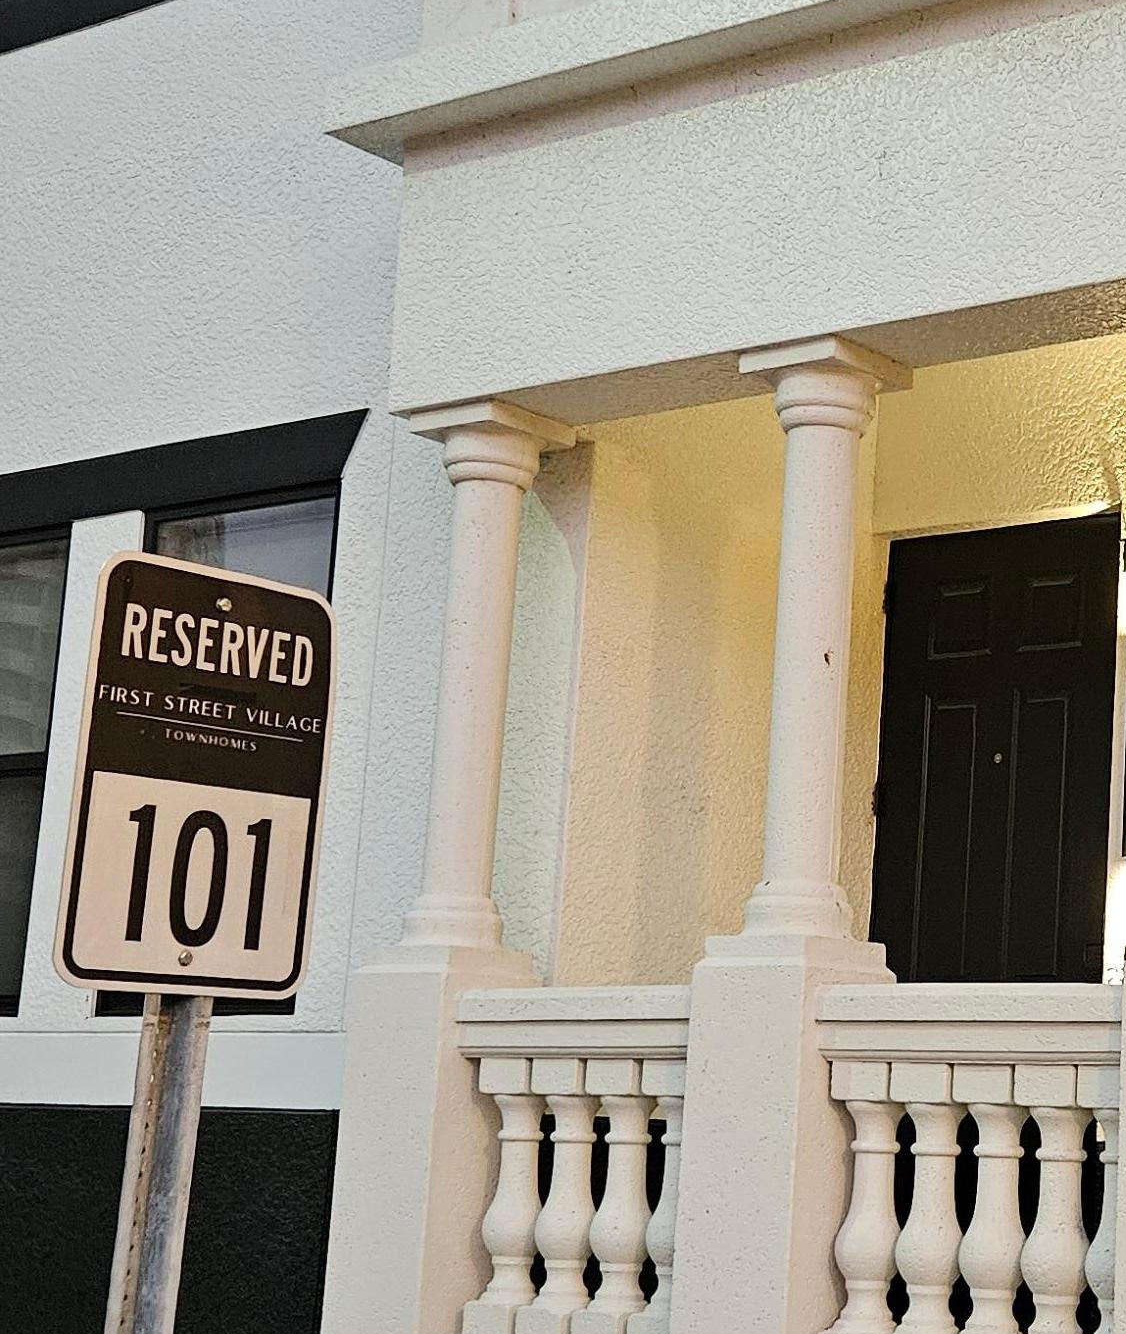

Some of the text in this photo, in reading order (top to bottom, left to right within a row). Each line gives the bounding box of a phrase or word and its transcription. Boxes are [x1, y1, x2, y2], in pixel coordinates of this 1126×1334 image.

[121, 602, 313, 687] RESERVED
[99, 684, 322, 734] FIRST STREET VILLAGE
[164, 728, 257, 752] TOWNHOMES
[125, 804, 272, 951] 101
